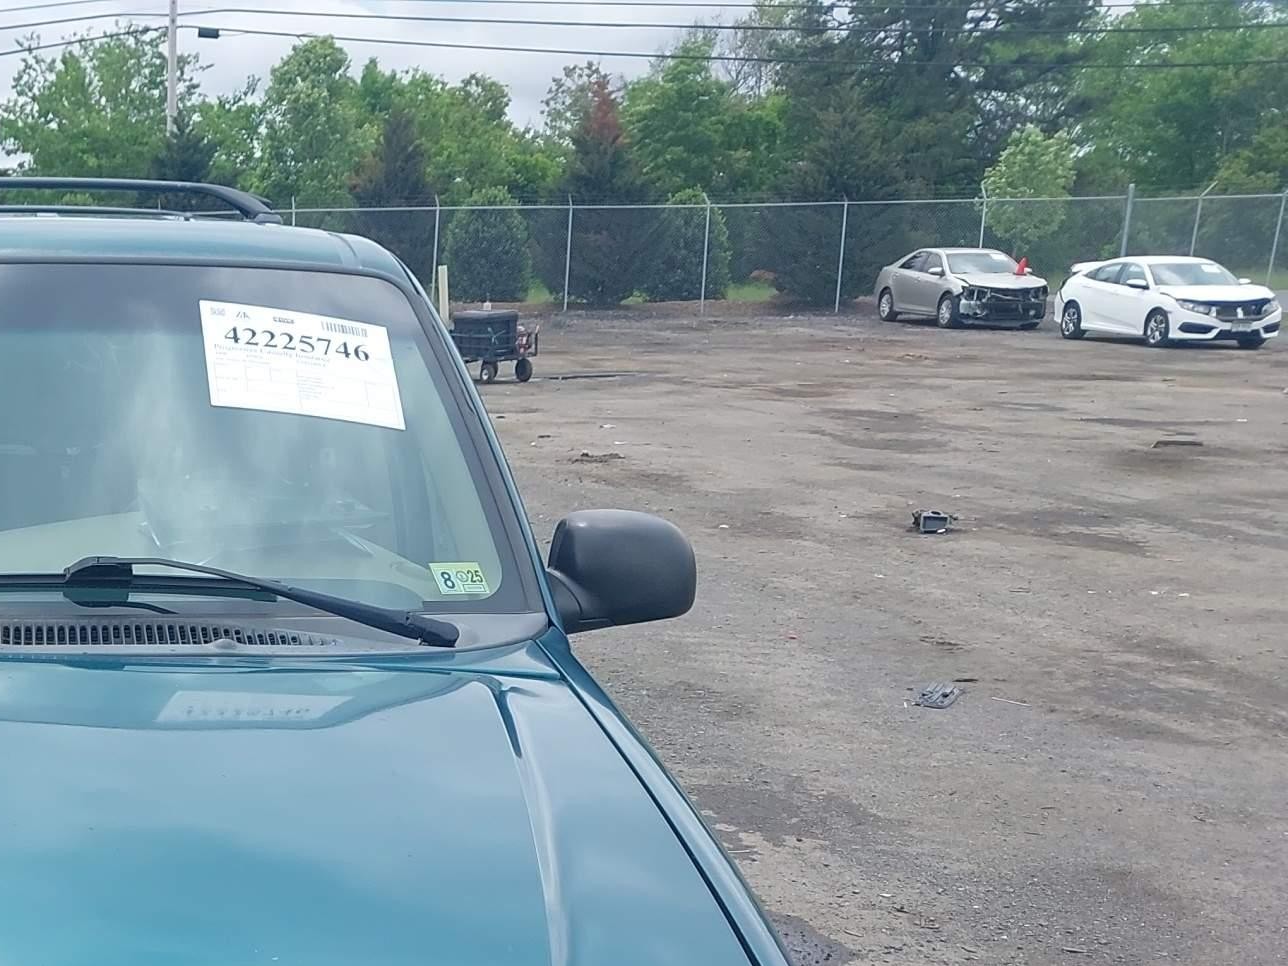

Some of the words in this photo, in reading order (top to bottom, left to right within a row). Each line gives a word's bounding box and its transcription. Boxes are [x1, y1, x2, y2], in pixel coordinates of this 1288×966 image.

[224, 326, 370, 361] 42225746
[440, 571, 456, 589] 8
[467, 569, 484, 583] 25
